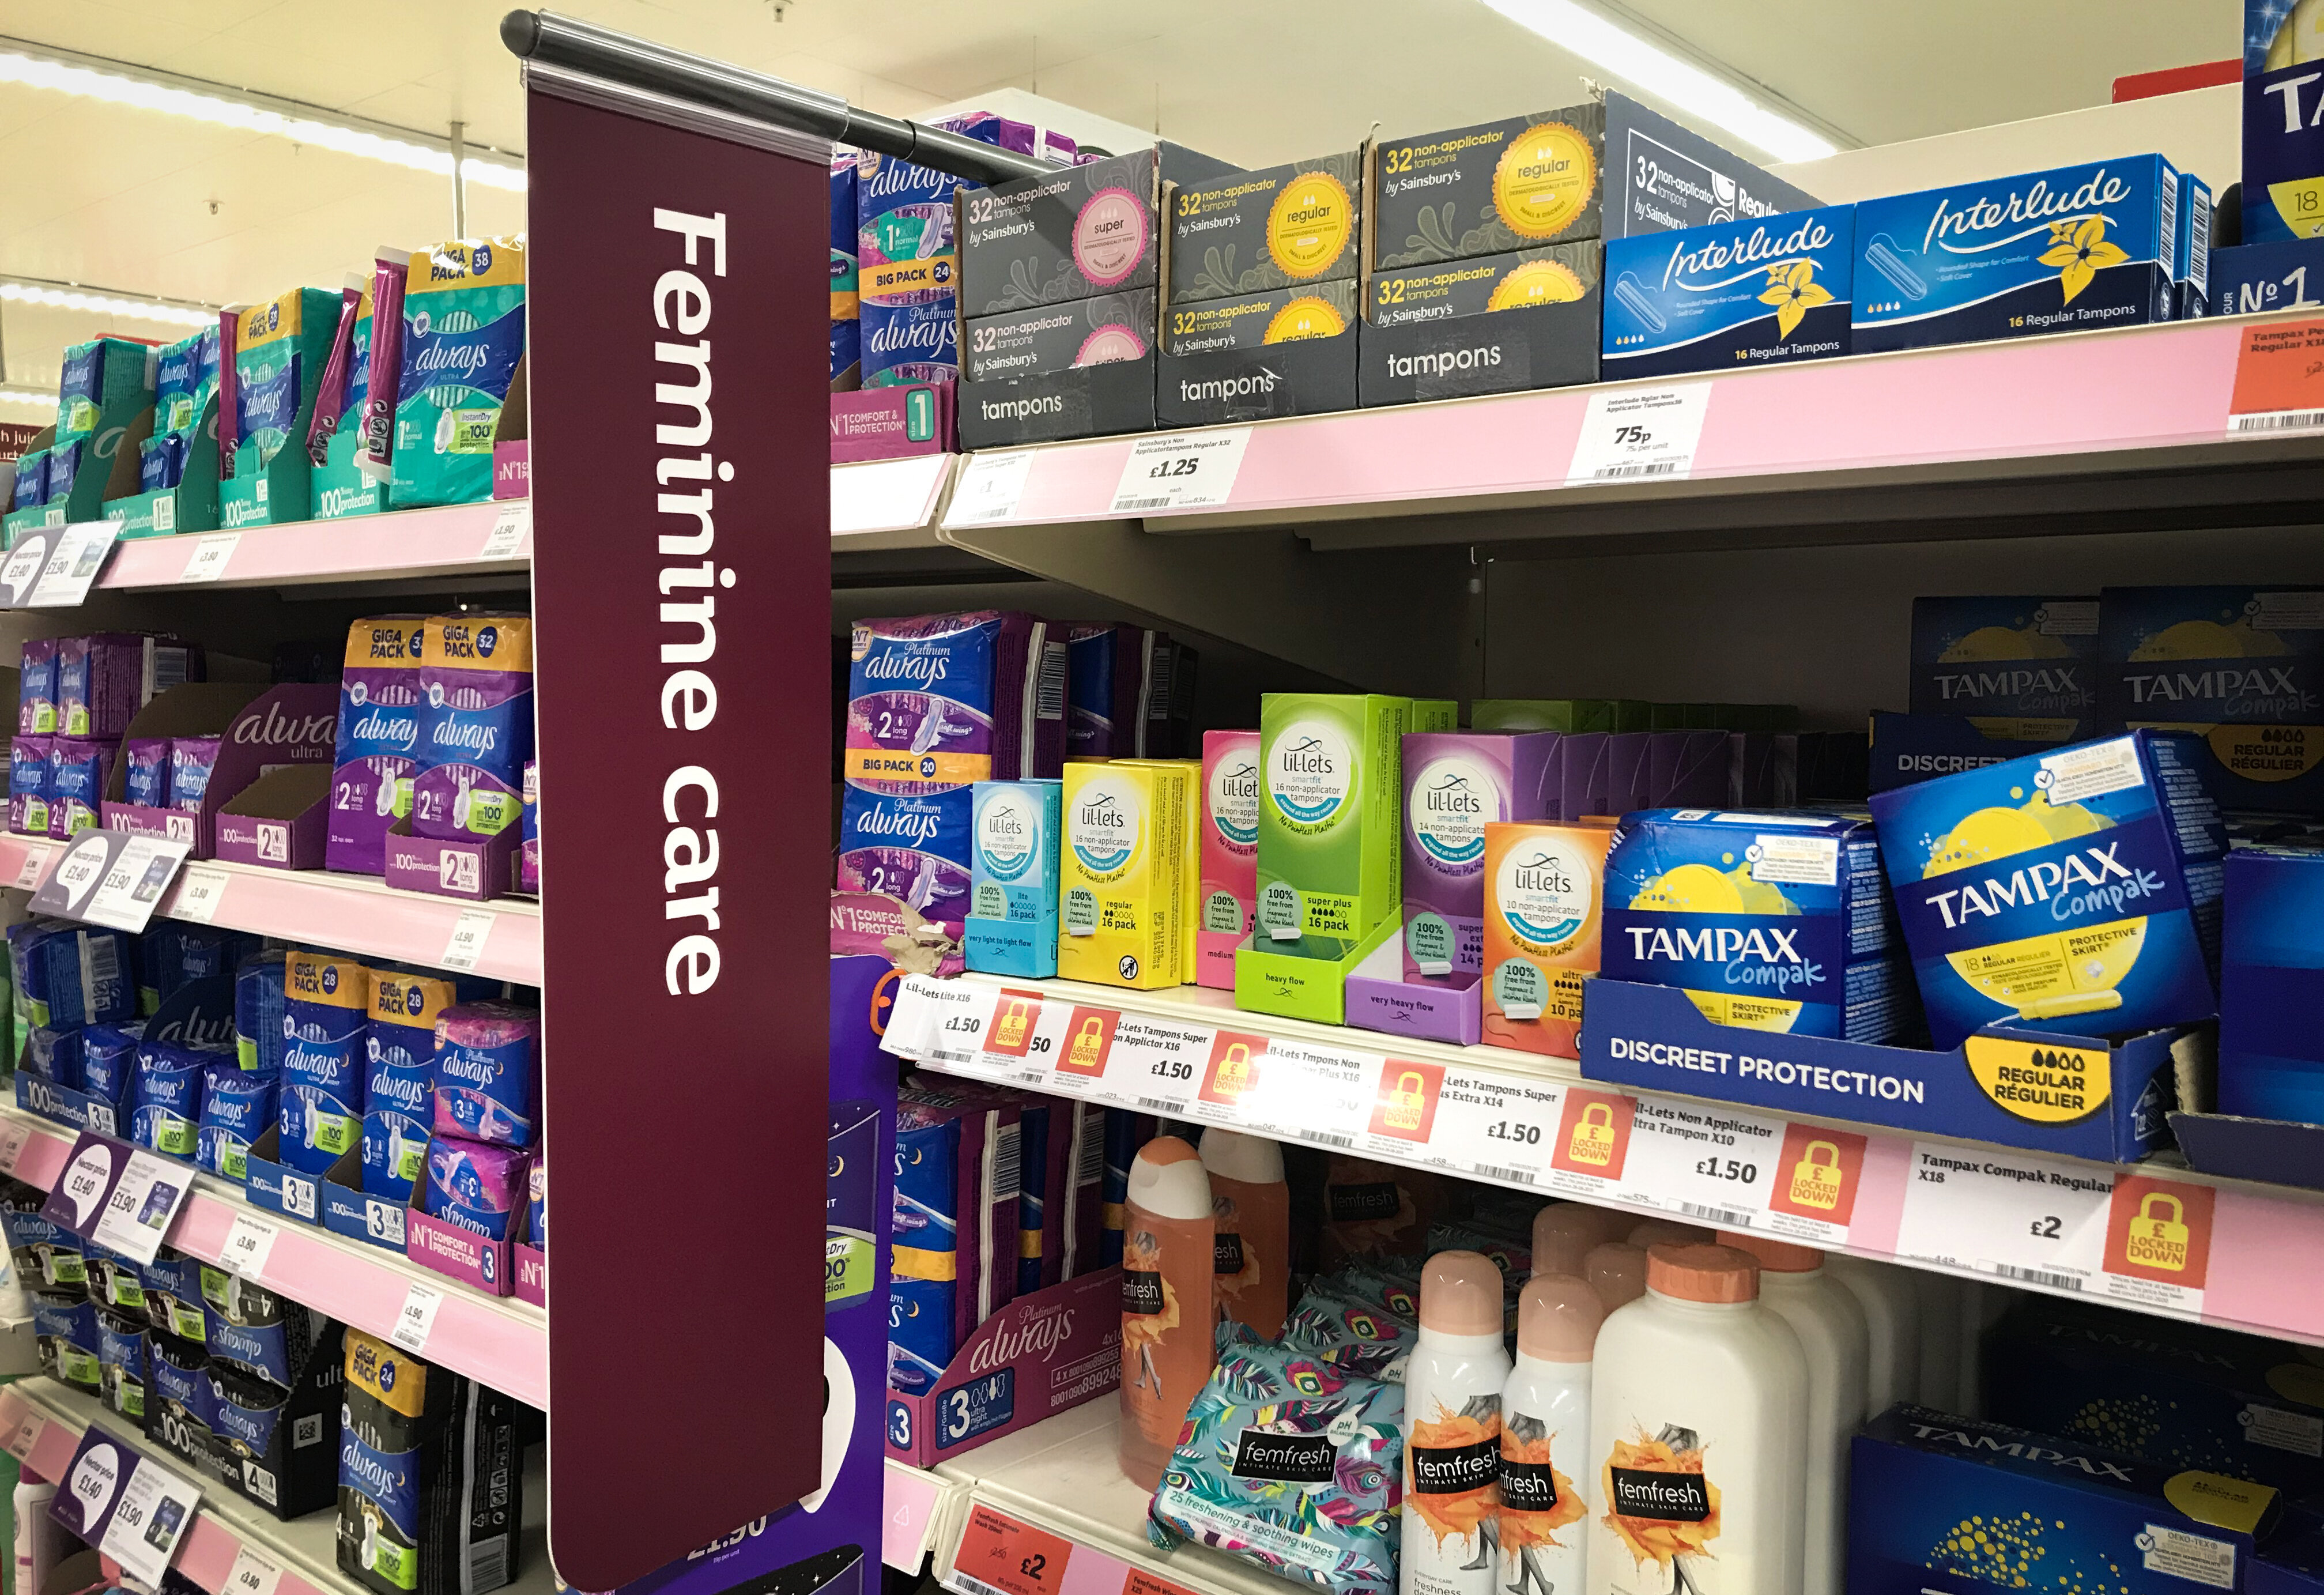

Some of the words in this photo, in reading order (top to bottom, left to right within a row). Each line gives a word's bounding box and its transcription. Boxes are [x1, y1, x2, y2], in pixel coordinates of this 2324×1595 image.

[1386, 148, 1413, 174] 32
[1414, 130, 1504, 159] non-applicator
[969, 198, 993, 224] 32
[994, 180, 1071, 207] non-applicator
[994, 203, 1031, 220] tampons
[1923, 168, 2131, 254] Interlude
[2295, 191, 2318, 213] 18
[1287, 204, 1331, 224] regular
[969, 232, 980, 247] by
[983, 220, 1035, 242] Sainsbury's
[1095, 218, 1124, 235] super
[1663, 217, 1834, 291] Interlude
[431, 264, 466, 282] PACK
[474, 251, 489, 267] 38
[876, 272, 893, 285] BIG
[896, 268, 926, 283] PACK
[935, 265, 949, 277] 24
[2224, 292, 2233, 315] OUR
[2009, 316, 2024, 327] 16
[2026, 311, 2074, 328] Regular
[2077, 304, 2136, 322] Tampons
[871, 315, 957, 358] always
[2251, 341, 2302, 353] Regular
[2253, 330, 2304, 341] Tampax
[416, 337, 489, 379] always
[1388, 346, 1501, 378] tampons
[1180, 374, 1274, 403] tampons
[245, 388, 282, 421] always
[982, 395, 1062, 421] tampons
[1138, 439, 1171, 447] Sainsbury's
[1193, 441, 1217, 450] Regular
[1614, 426, 1651, 444] 75p
[654, 207, 735, 731] Feminine
[1149, 458, 1199, 478] £1.25
[321, 488, 341, 517] 100
[341, 492, 375, 510] protection
[443, 626, 469, 641] GIGA
[444, 642, 474, 658] PACK
[479, 635, 493, 648] 32
[904, 641, 950, 657] Platinum
[865, 646, 947, 690] always
[2123, 666, 2295, 703] TAMPAX
[235, 702, 337, 745] alwa
[893, 726, 908, 737] long
[433, 712, 497, 760] always
[291, 745, 322, 758] ultra
[2234, 742, 2304, 757] REGULAR
[863, 759, 882, 771] BIG
[884, 760, 914, 773] PACK
[921, 760, 935, 773] 20
[1284, 754, 1333, 774] lil-lets
[2230, 754, 2304, 771] RÉGULIER
[990, 819, 1022, 834] lil-lets
[1082, 805, 1123, 828] lil-lets
[1437, 815, 1470, 823] smartfit
[1084, 837, 1130, 847] non-applicator
[1088, 844, 1115, 854] tampons
[413, 861, 440, 872] protection
[460, 874, 473, 884] long
[663, 766, 721, 997] care
[1926, 842, 2133, 929] TAMPAX
[1018, 892, 1028, 900] lite
[1071, 891, 1092, 901] 100%
[1106, 900, 1132, 910] regular
[1307, 896, 1331, 906] super
[1333, 898, 1352, 908] plus
[2051, 868, 2165, 922] Compak
[1102, 918, 1112, 927] 16
[1115, 918, 1136, 930] pack
[455, 932, 474, 942] £1.90
[982, 936, 995, 944] light
[1004, 937, 1017, 947] light
[1018, 939, 1032, 947] flow
[1625, 927, 1802, 964] TAMPAX
[2069, 927, 2137, 947] PROTECTIVE
[295, 962, 316, 978] GIGA
[1725, 957, 1827, 994] Compak
[294, 978, 320, 994] PACK
[325, 972, 335, 986] 28
[906, 983, 939, 999] Lil-Lets
[941, 991, 955, 1001] Lite
[956, 994, 971, 1002] X16
[1371, 995, 1389, 1004] very
[1391, 997, 1414, 1011] heavy
[1416, 1001, 1433, 1012] flow
[945, 1016, 980, 1033] £1.50
[999, 1027, 1024, 1035] LOCKED
[1144, 1025, 1181, 1040] Tampons
[1182, 1032, 1208, 1045] Super
[997, 1033, 1022, 1043] DOWN
[1125, 1036, 1164, 1050] Applictor
[1164, 1041, 1180, 1051] X16
[285, 1042, 339, 1085] always
[443, 1049, 494, 1091] always
[1151, 1060, 1192, 1080] £1.50
[1610, 1038, 1732, 1074] DISCREET
[1739, 1055, 1925, 1103] PROTECTION
[1998, 1066, 2085, 1092] REGULAR
[28, 1080, 50, 1113] 100
[50, 1099, 87, 1125] protection
[1994, 1083, 2085, 1111] RÉGULIER
[1677, 1111, 1701, 1125] Non
[1704, 1117, 1772, 1138] Applicator
[1696, 1157, 1757, 1184] £1.50
[1921, 1153, 1980, 1175] Tampax
[1983, 1163, 2047, 1184] Compak
[2050, 1172, 2114, 1194] Regular
[1334, 1192, 1394, 1208] femfresh
[2030, 1216, 2062, 1240] £2
[433, 1233, 467, 1253] COMFORT
[405, 1305, 423, 1320] £1.90
[970, 1309, 1074, 1374] always
[354, 1344, 377, 1368] GIGA
[352, 1362, 378, 1386] PACK
[382, 1368, 393, 1383] 24
[219, 1405, 258, 1441] always
[1245, 1441, 1330, 1465] femfresh
[1909, 1423, 2136, 1483] TAMPAX
[342, 1440, 395, 1497] always
[1617, 1476, 1701, 1505] femfresh
[1169, 1491, 1183, 1503] 25
[1184, 1495, 1240, 1527] freshening
[1242, 1521, 1250, 1529] &
[1252, 1524, 1297, 1547] soothing
[1300, 1541, 1334, 1559] wipes
[1020, 1554, 1046, 1581] £2
